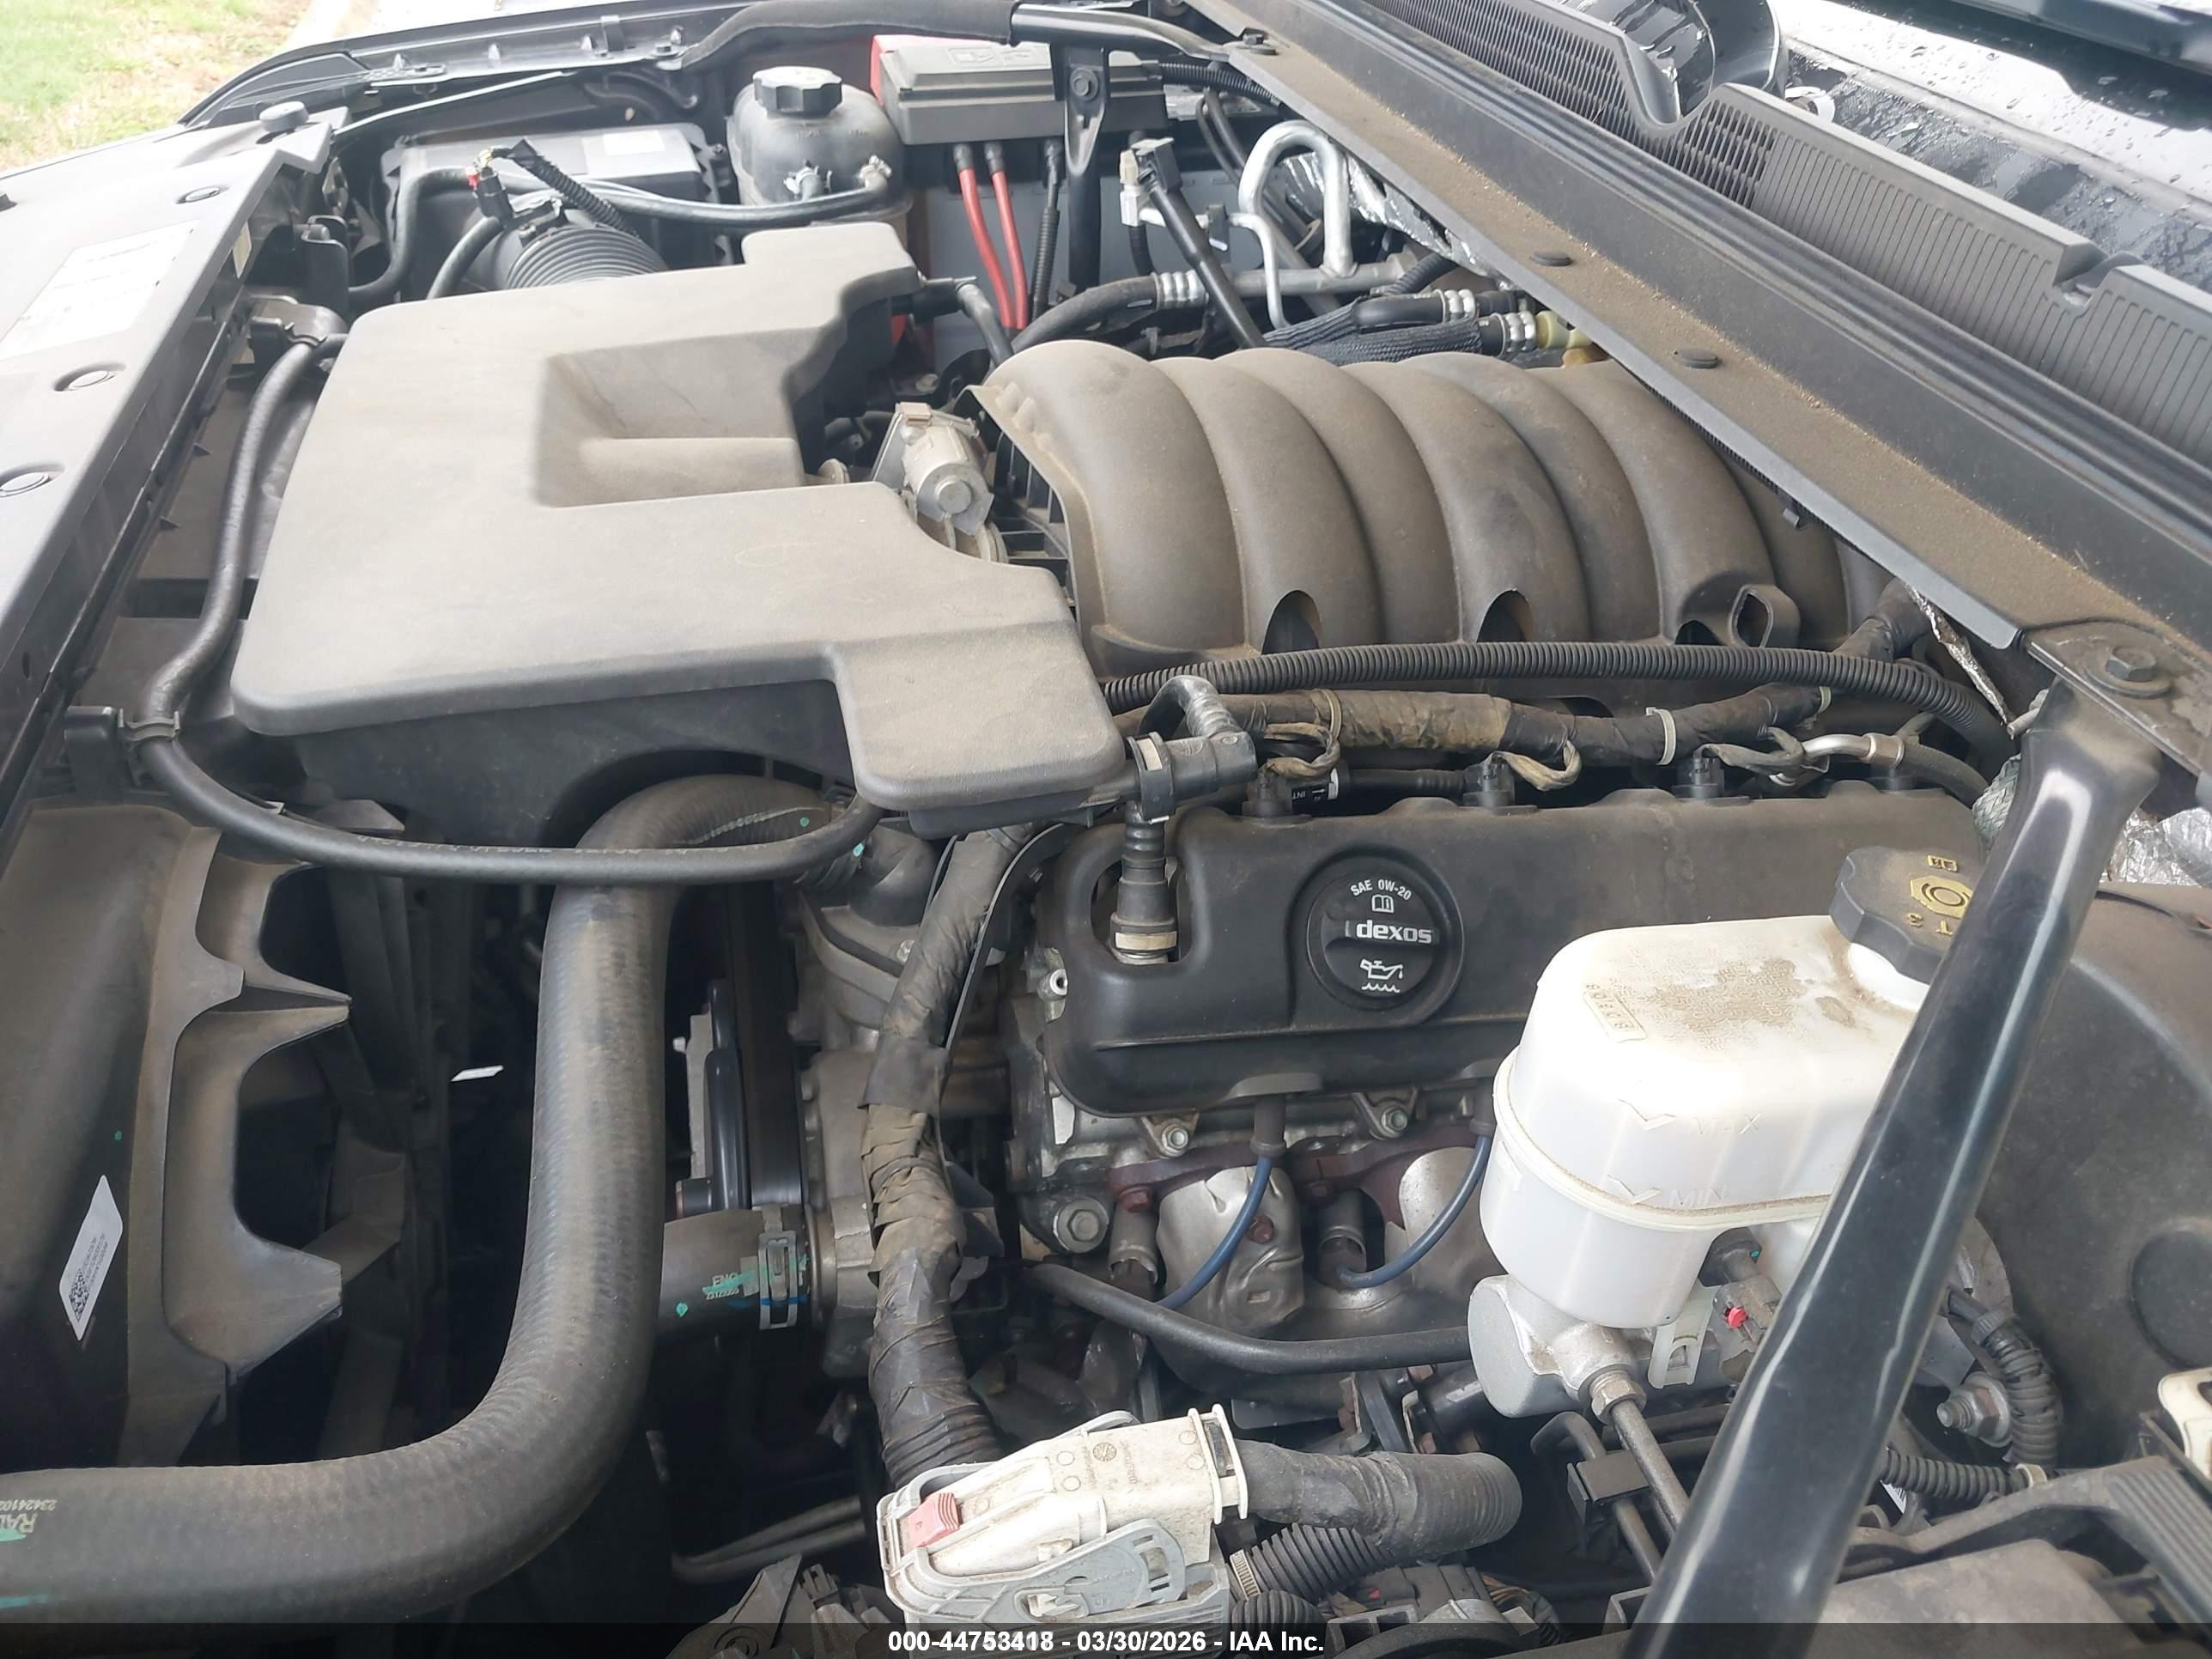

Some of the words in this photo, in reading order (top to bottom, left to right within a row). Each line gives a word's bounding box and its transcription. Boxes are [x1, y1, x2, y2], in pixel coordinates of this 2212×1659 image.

[1350, 878, 1373, 896] SAE
[1378, 878, 1413, 901] 0W-20
[1356, 919, 1433, 944] dexos
